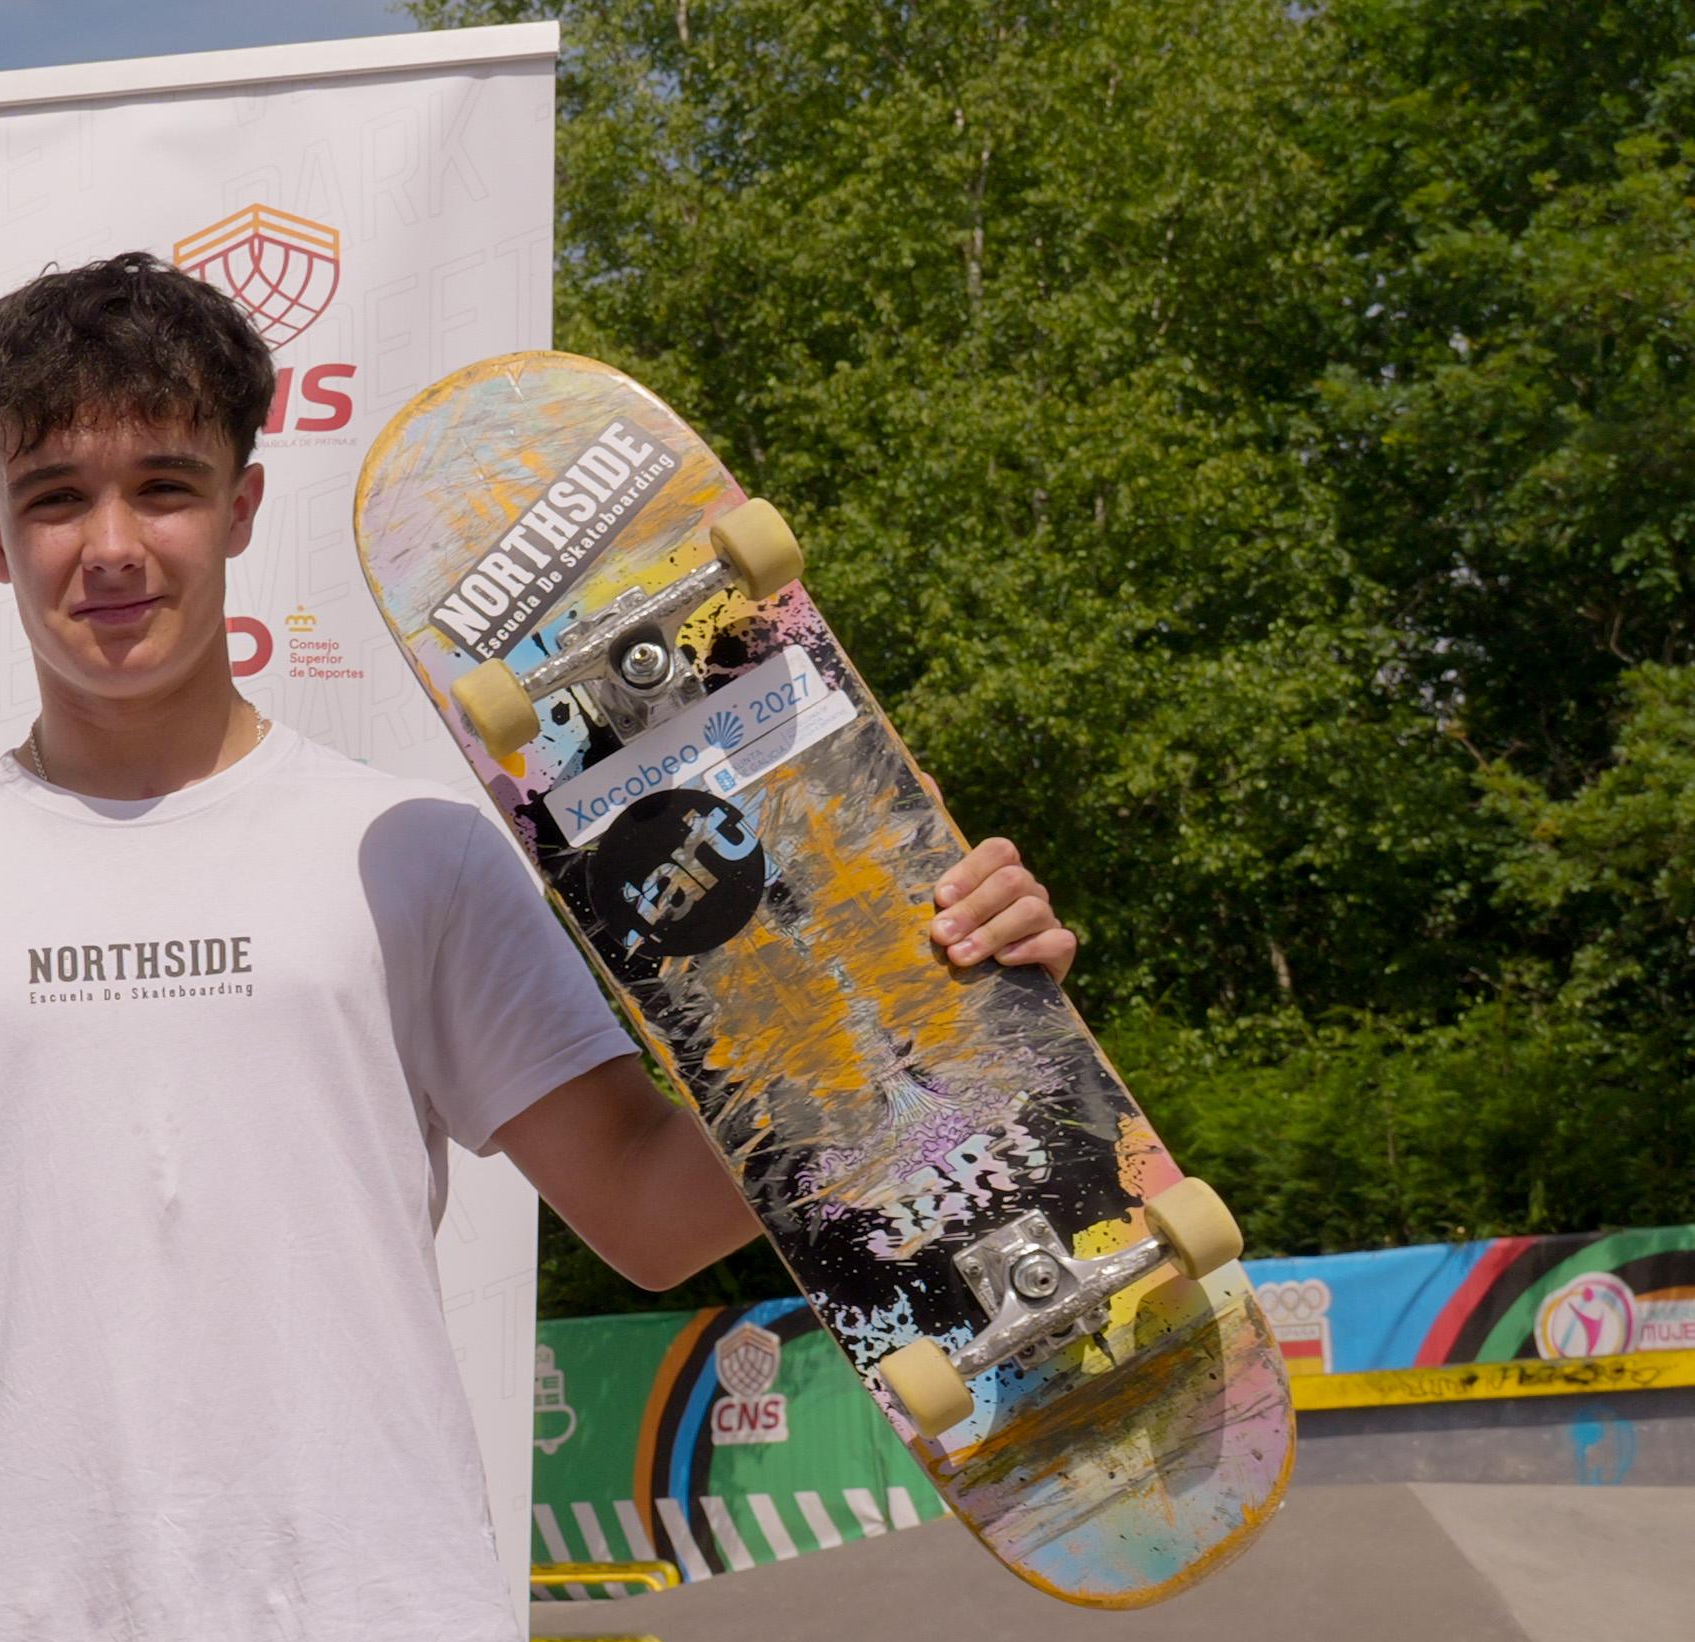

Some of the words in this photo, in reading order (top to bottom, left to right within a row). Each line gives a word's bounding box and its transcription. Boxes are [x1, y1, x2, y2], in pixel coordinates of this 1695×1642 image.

[434, 421, 654, 646] NORTHSIDE
[476, 594, 542, 660] Escuela
[539, 568, 564, 595] De
[559, 452, 676, 569] Skateboarding
[289, 639, 339, 655] Consejo
[290, 653, 343, 666] Superior
[289, 667, 305, 679] de
[308, 668, 364, 680] Deportes
[566, 740, 700, 831] Xacobeo
[748, 673, 810, 725] 2027
[28, 937, 253, 984] NORTHSIDE
[30, 990, 93, 1004] Escuela
[104, 989, 121, 1001] De
[131, 983, 253, 999] Skateboarding
[717, 1400, 780, 1432] CNS
